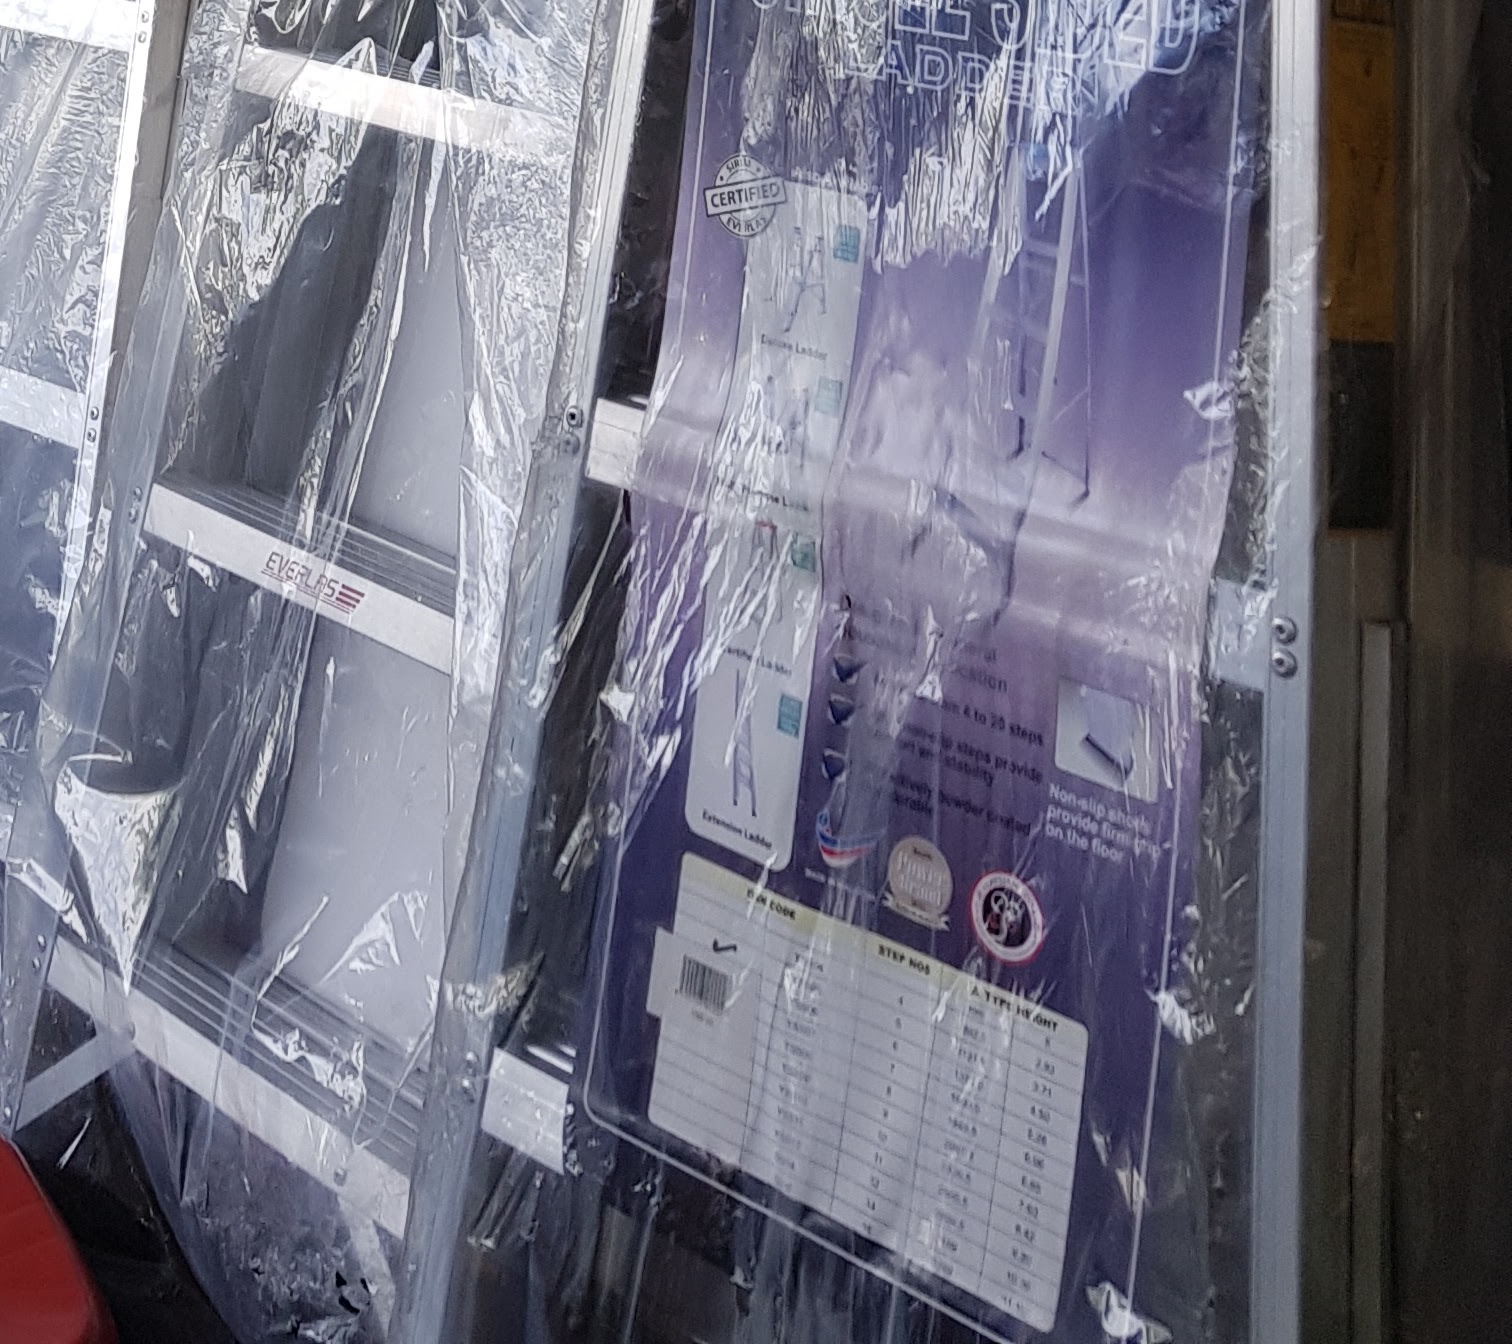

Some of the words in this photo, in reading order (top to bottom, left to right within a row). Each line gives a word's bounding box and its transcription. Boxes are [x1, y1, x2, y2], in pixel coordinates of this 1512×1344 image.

[710, 181, 781, 209] CERTIFIED
[265, 550, 340, 599] EVERLAS
[974, 710, 987, 724] to
[1009, 720, 1044, 746] steps
[957, 741, 992, 766] steps
[994, 755, 1043, 784] provide
[1049, 782, 1104, 819] Non-slip
[701, 809, 743, 839] Extension
[1045, 803, 1098, 836] provide
[1102, 818, 1132, 846] firm
[1045, 823, 1065, 841] on
[1066, 828, 1088, 851] the
[1090, 836, 1124, 862] floor
[908, 957, 931, 975] NOS
[971, 984, 980, 997] A
[1016, 1005, 1059, 1033] HEGHT
